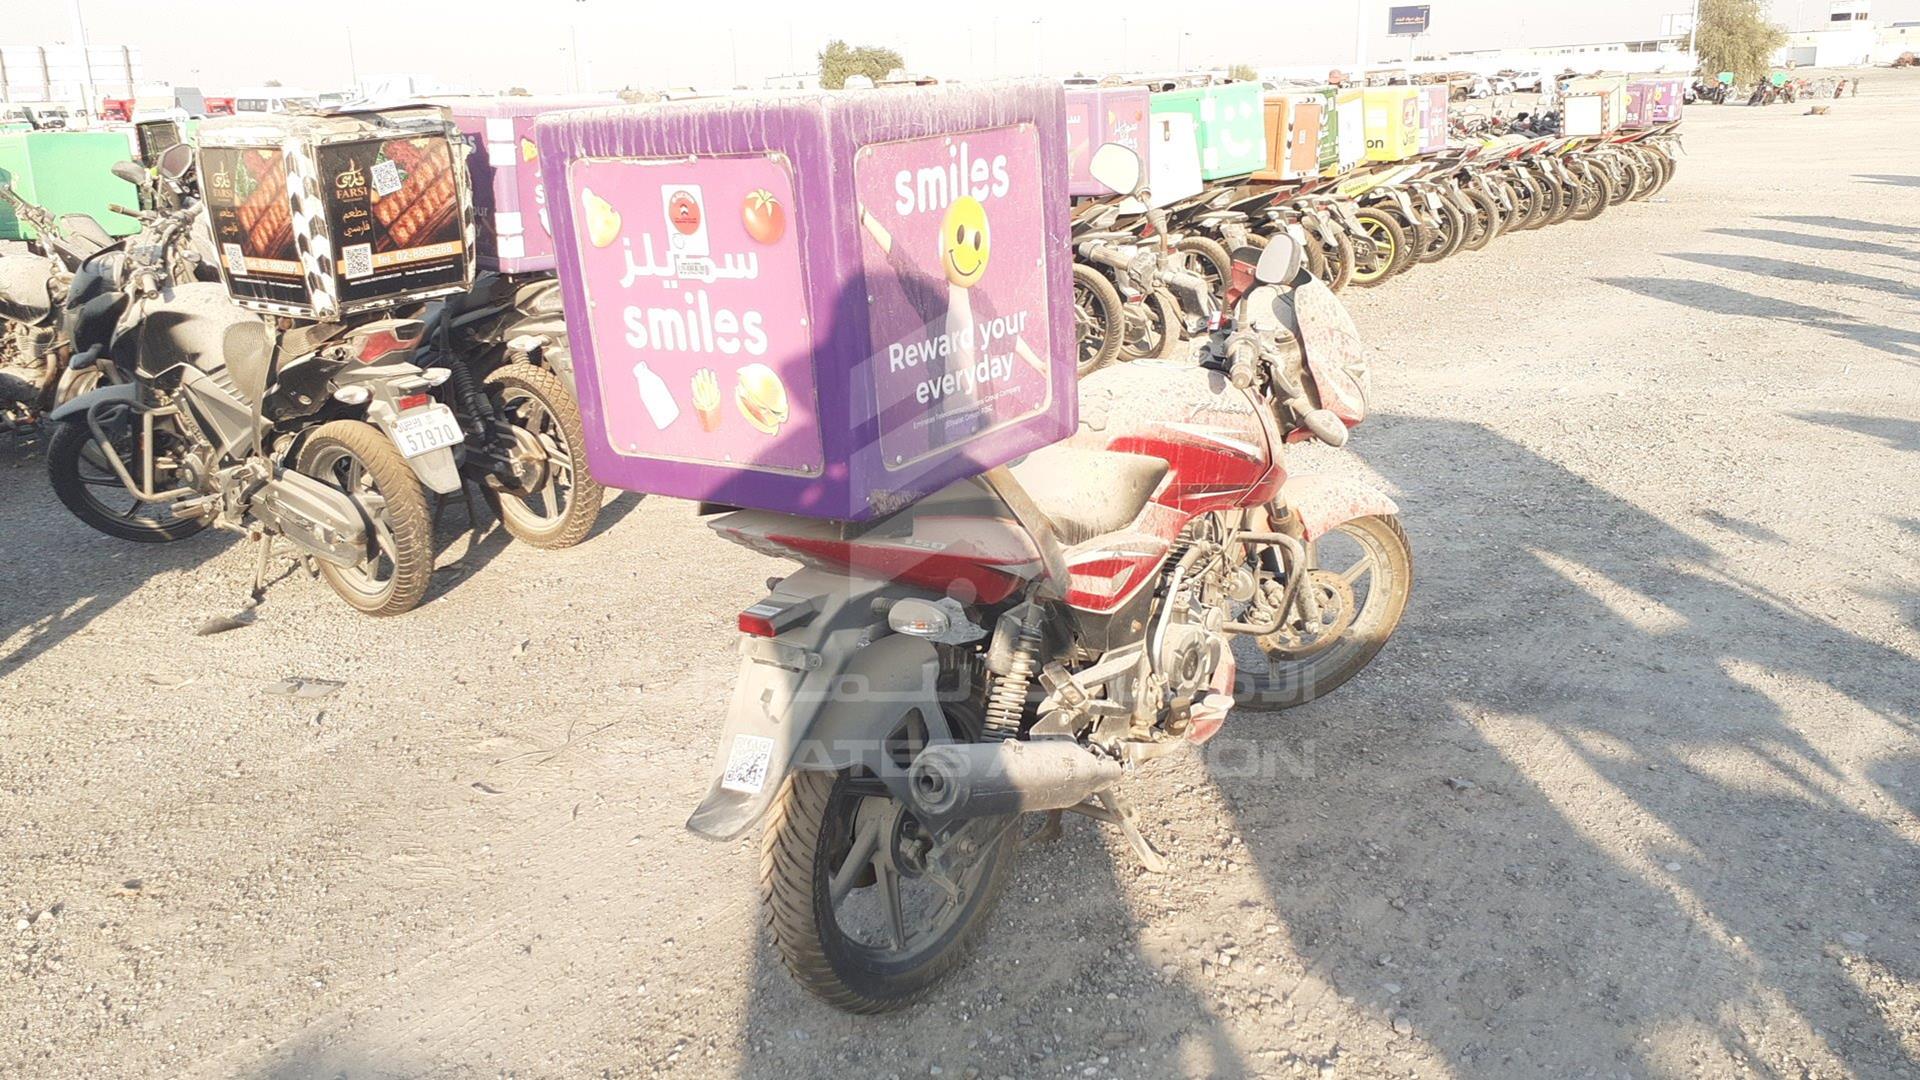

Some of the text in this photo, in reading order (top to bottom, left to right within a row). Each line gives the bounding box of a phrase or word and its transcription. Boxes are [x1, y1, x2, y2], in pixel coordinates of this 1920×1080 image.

[336, 187, 368, 200] FARSI
[895, 142, 1009, 216] smiles
[343, 208, 368, 223] مطعم
[344, 221, 371, 238] فارسي
[624, 289, 768, 355] smiles
[888, 311, 1028, 373] Reward your
[916, 352, 1014, 404] everyday
[407, 424, 455, 452] 57970
